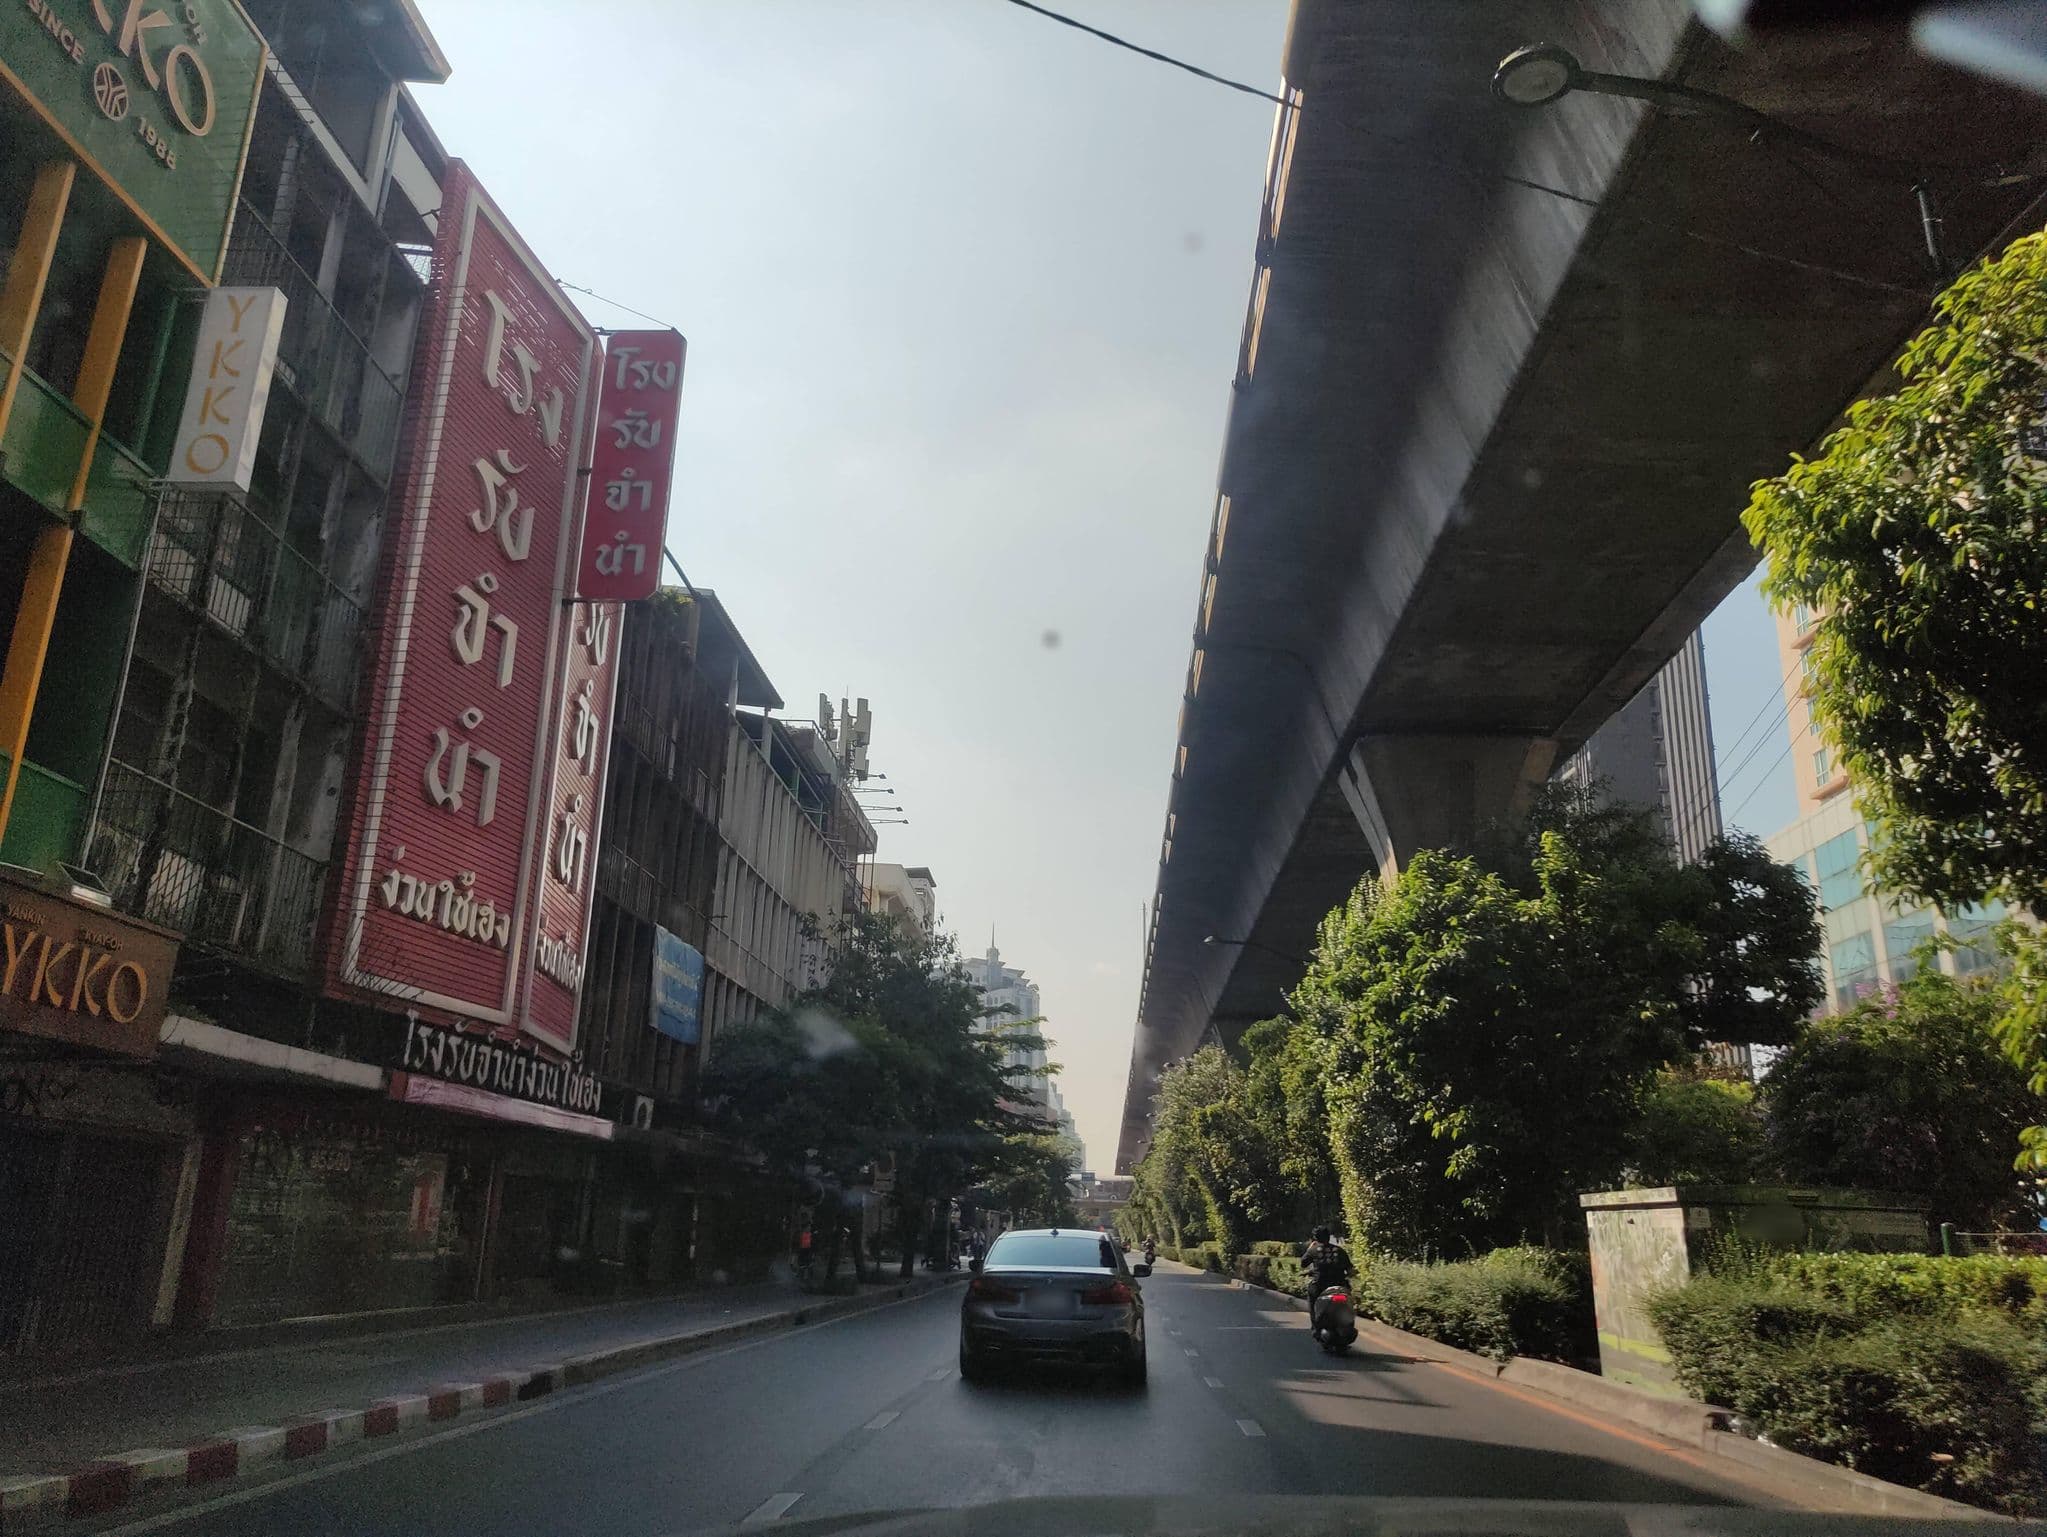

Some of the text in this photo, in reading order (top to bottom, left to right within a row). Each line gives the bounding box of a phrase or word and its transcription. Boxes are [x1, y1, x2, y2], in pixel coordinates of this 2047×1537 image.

[138, 116, 177, 171] 1988
[185, 295, 257, 475] YKKO
[482, 289, 565, 446] โรง
[612, 346, 677, 391] โรง
[610, 407, 662, 450] รับ
[469, 449, 536, 561] รับ
[604, 466, 653, 513] จำ
[594, 529, 647, 577] นำ
[452, 571, 519, 688] จำ
[424, 706, 501, 828] นำ
[1, 922, 149, 1024] YKKO
